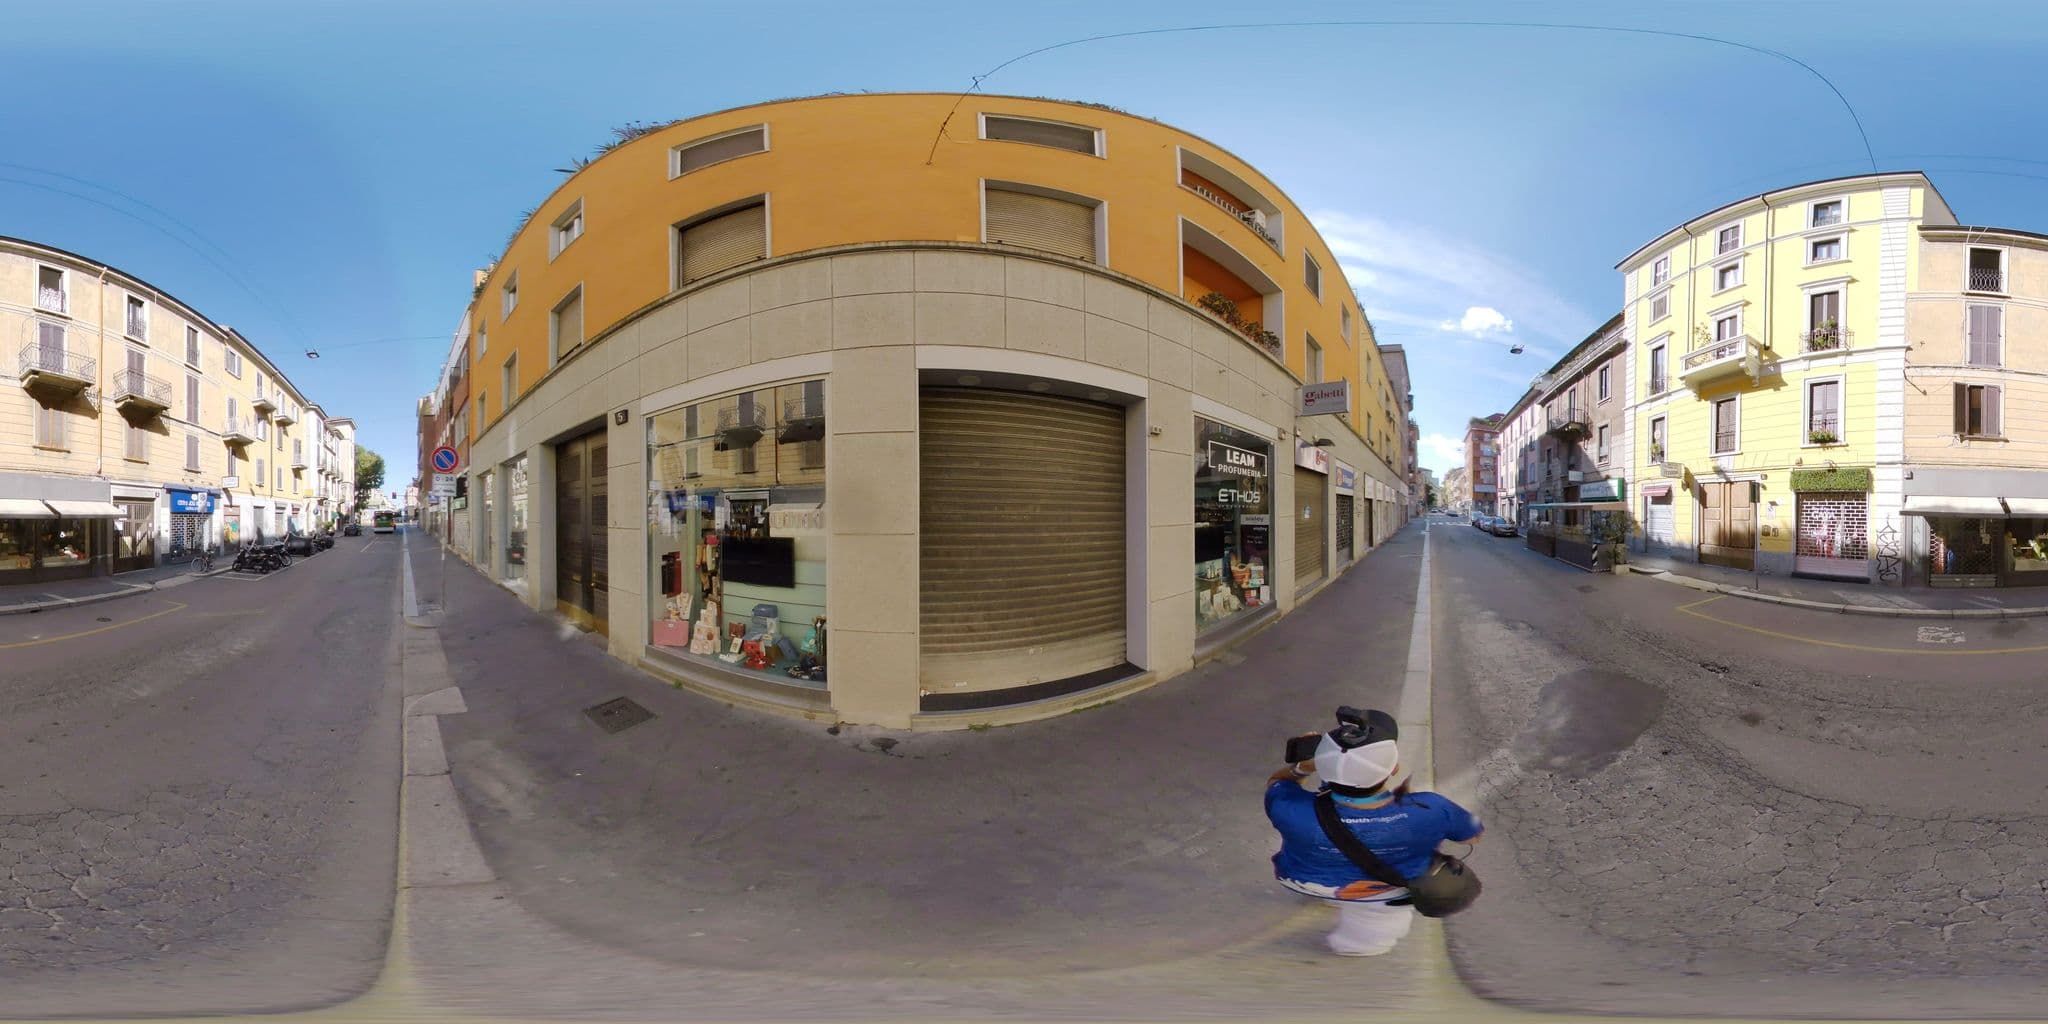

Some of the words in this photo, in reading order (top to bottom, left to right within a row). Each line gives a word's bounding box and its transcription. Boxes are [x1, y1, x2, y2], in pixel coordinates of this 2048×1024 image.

[1304, 388, 1345, 407] gabetti
[1226, 449, 1256, 468] LEAM
[1217, 463, 1262, 478] PROFUMERIA
[1218, 488, 1261, 504] ETHOS
